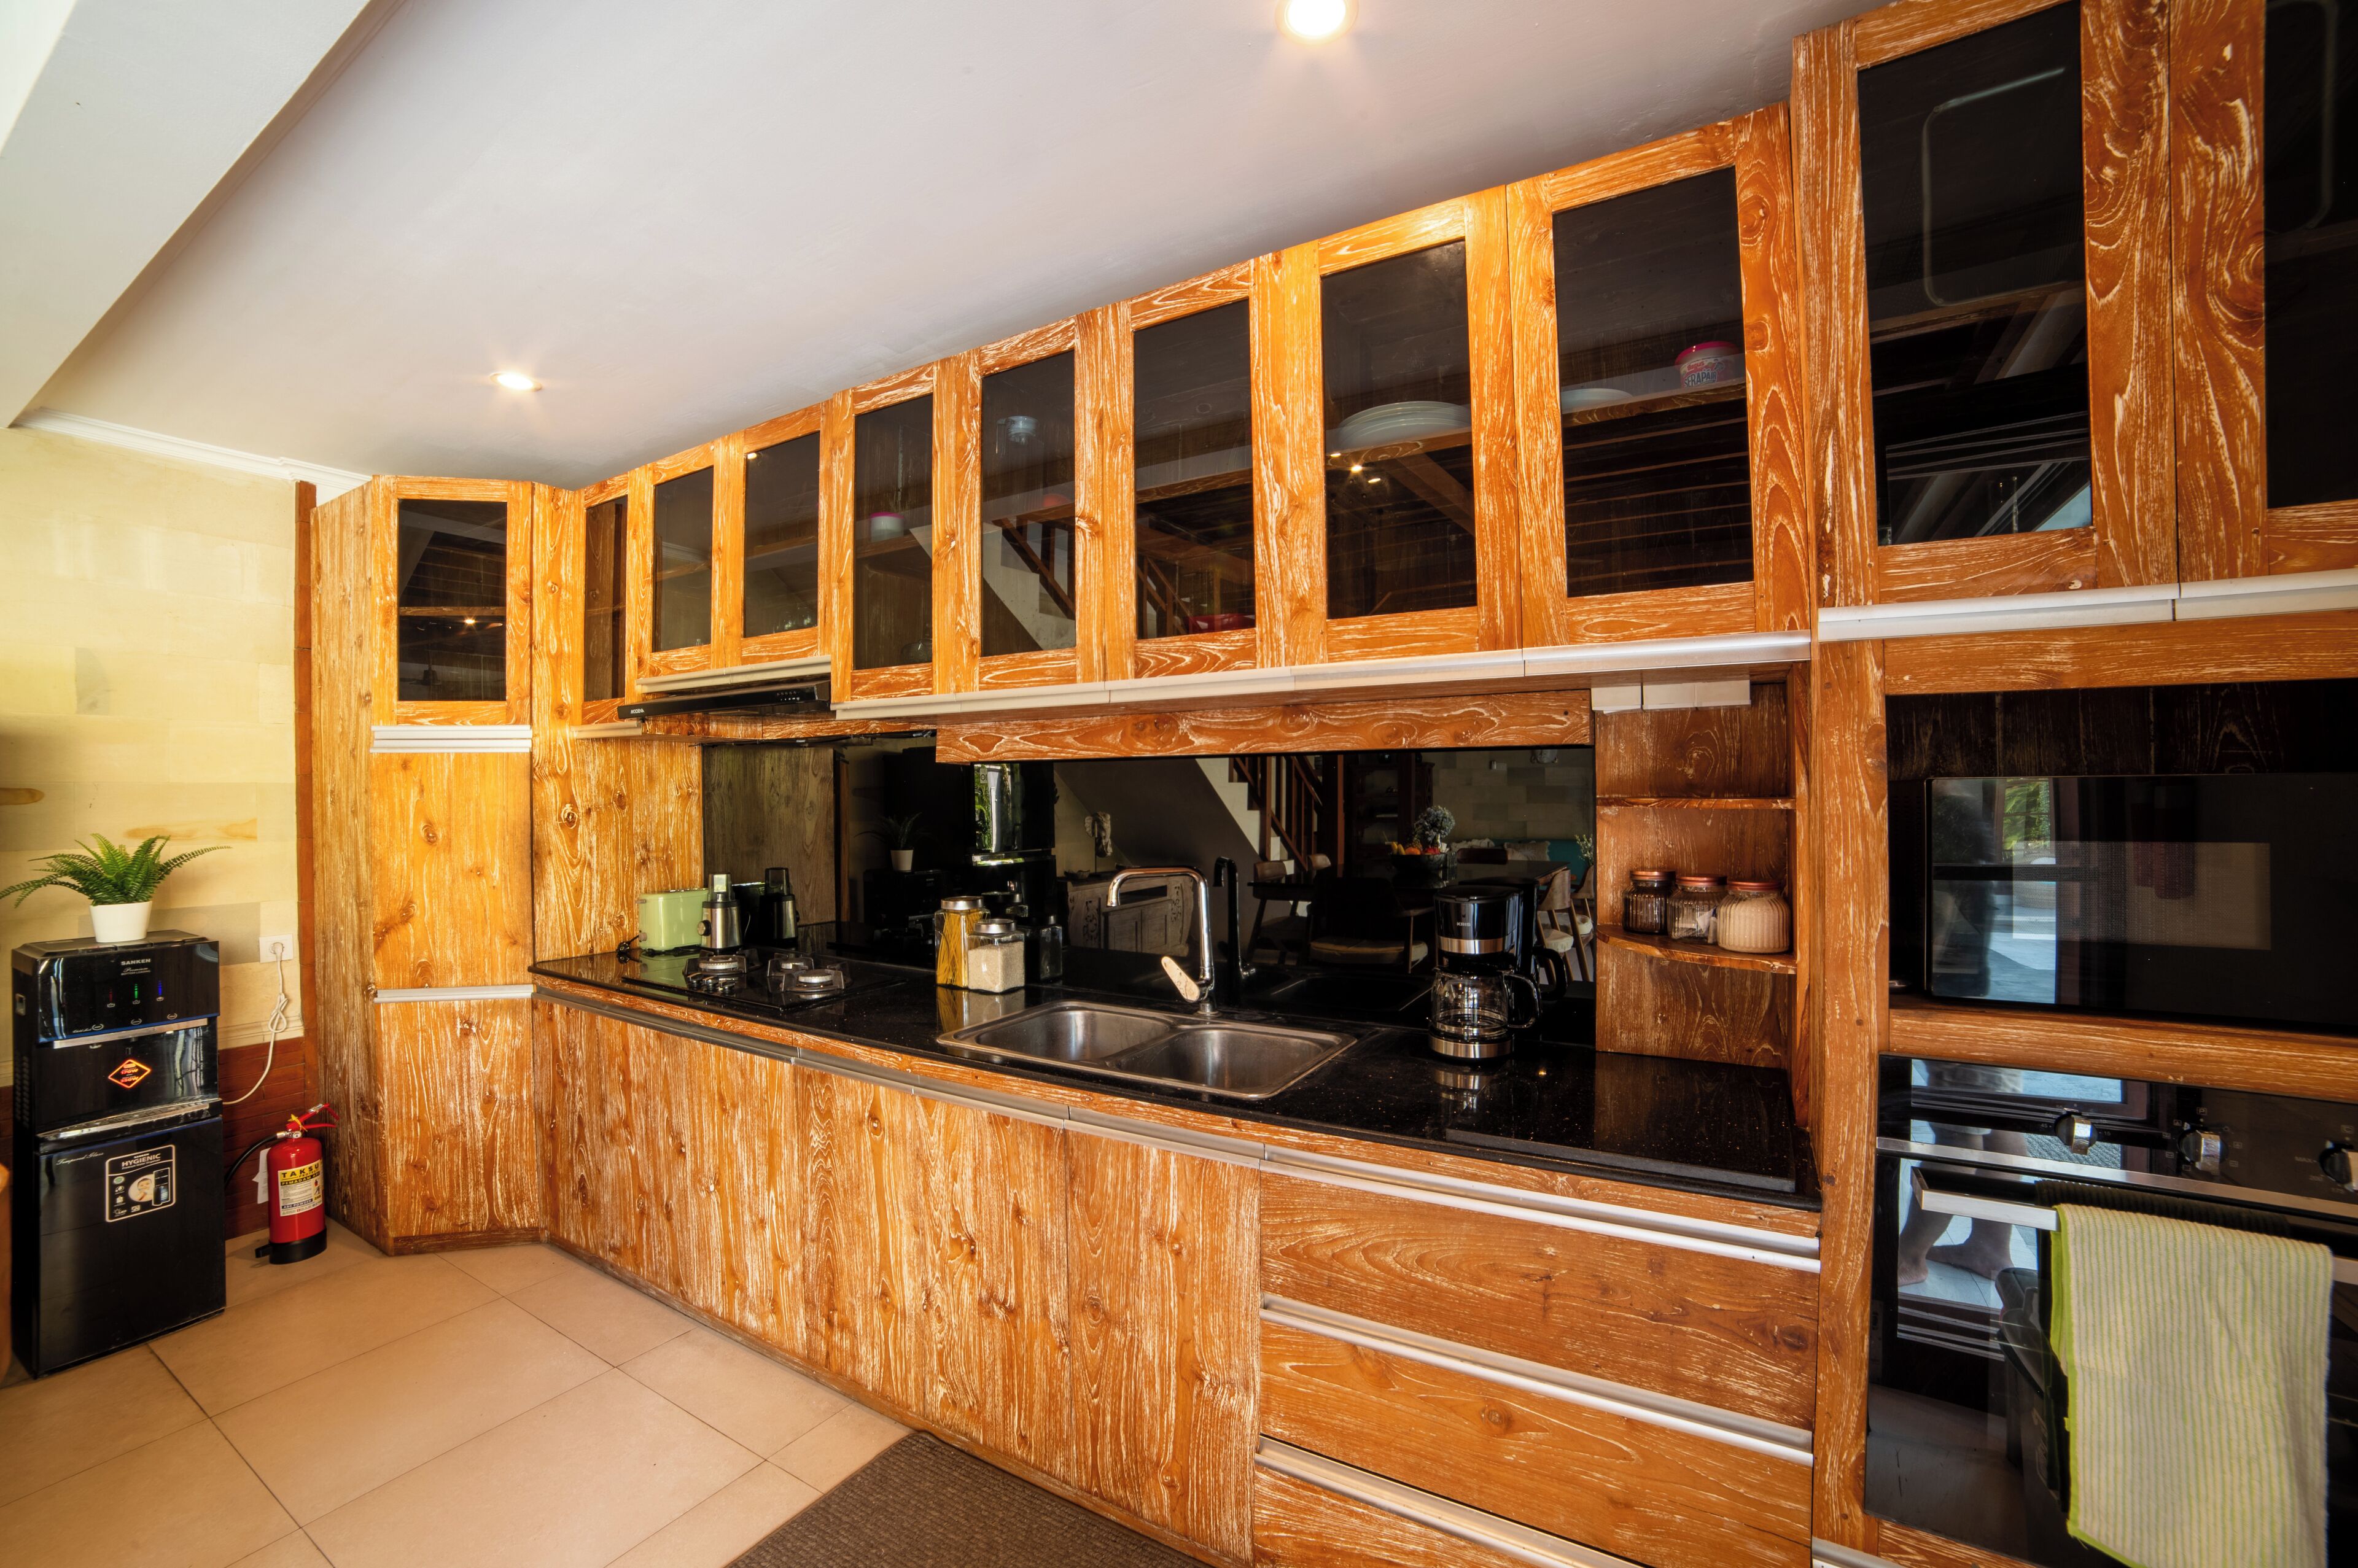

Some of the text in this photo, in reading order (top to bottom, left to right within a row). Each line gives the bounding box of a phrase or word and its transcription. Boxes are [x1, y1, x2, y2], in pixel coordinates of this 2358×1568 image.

[55, 1155, 86, 1165] Tempered
[122, 1153, 161, 1167] HYGIENIC
[282, 1163, 319, 1178] TAKSU
[282, 1176, 311, 1186] PEMADAM
